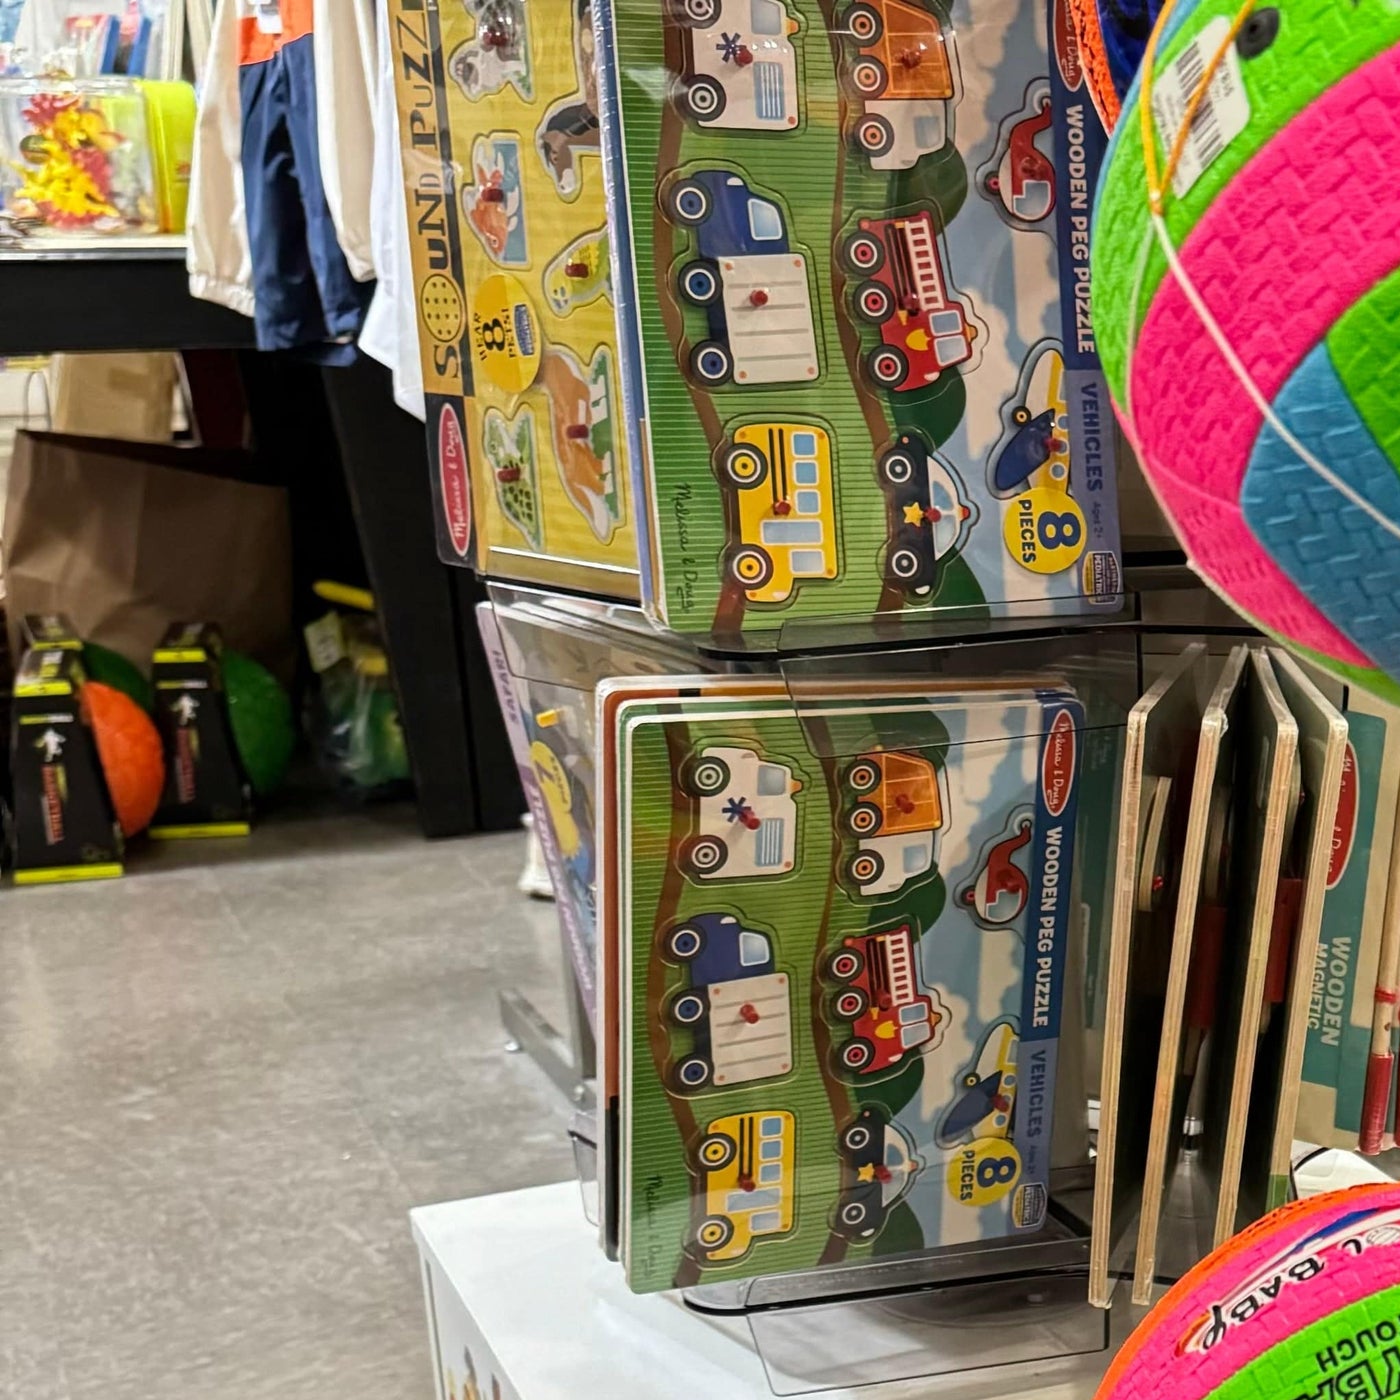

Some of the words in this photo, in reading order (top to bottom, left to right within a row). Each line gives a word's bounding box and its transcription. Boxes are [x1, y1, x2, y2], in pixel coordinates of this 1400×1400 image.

[1066, 105, 1088, 209] WOODEN
[1071, 216, 1089, 260] PEG
[483, 318, 505, 352] 8
[1074, 267, 1095, 353] PUZZLE
[1081, 382, 1103, 492] VEHICLES
[671, 482, 692, 552] Melissa
[1018, 499, 1037, 563] PIECES
[1037, 511, 1081, 549] 8
[676, 571, 699, 614] Doug
[493, 650, 518, 724] SAFARI
[1041, 826, 1063, 911] WOODEN
[1037, 916, 1055, 953] PEG
[1032, 957, 1052, 1027] PUZZLE
[1308, 942, 1328, 1030] MAGNETIC
[1321, 936, 1351, 1047] WOODEN
[1027, 1050, 1047, 1138] VEHICLES
[960, 1150, 976, 1201] PIECES
[976, 1156, 1016, 1189] 8
